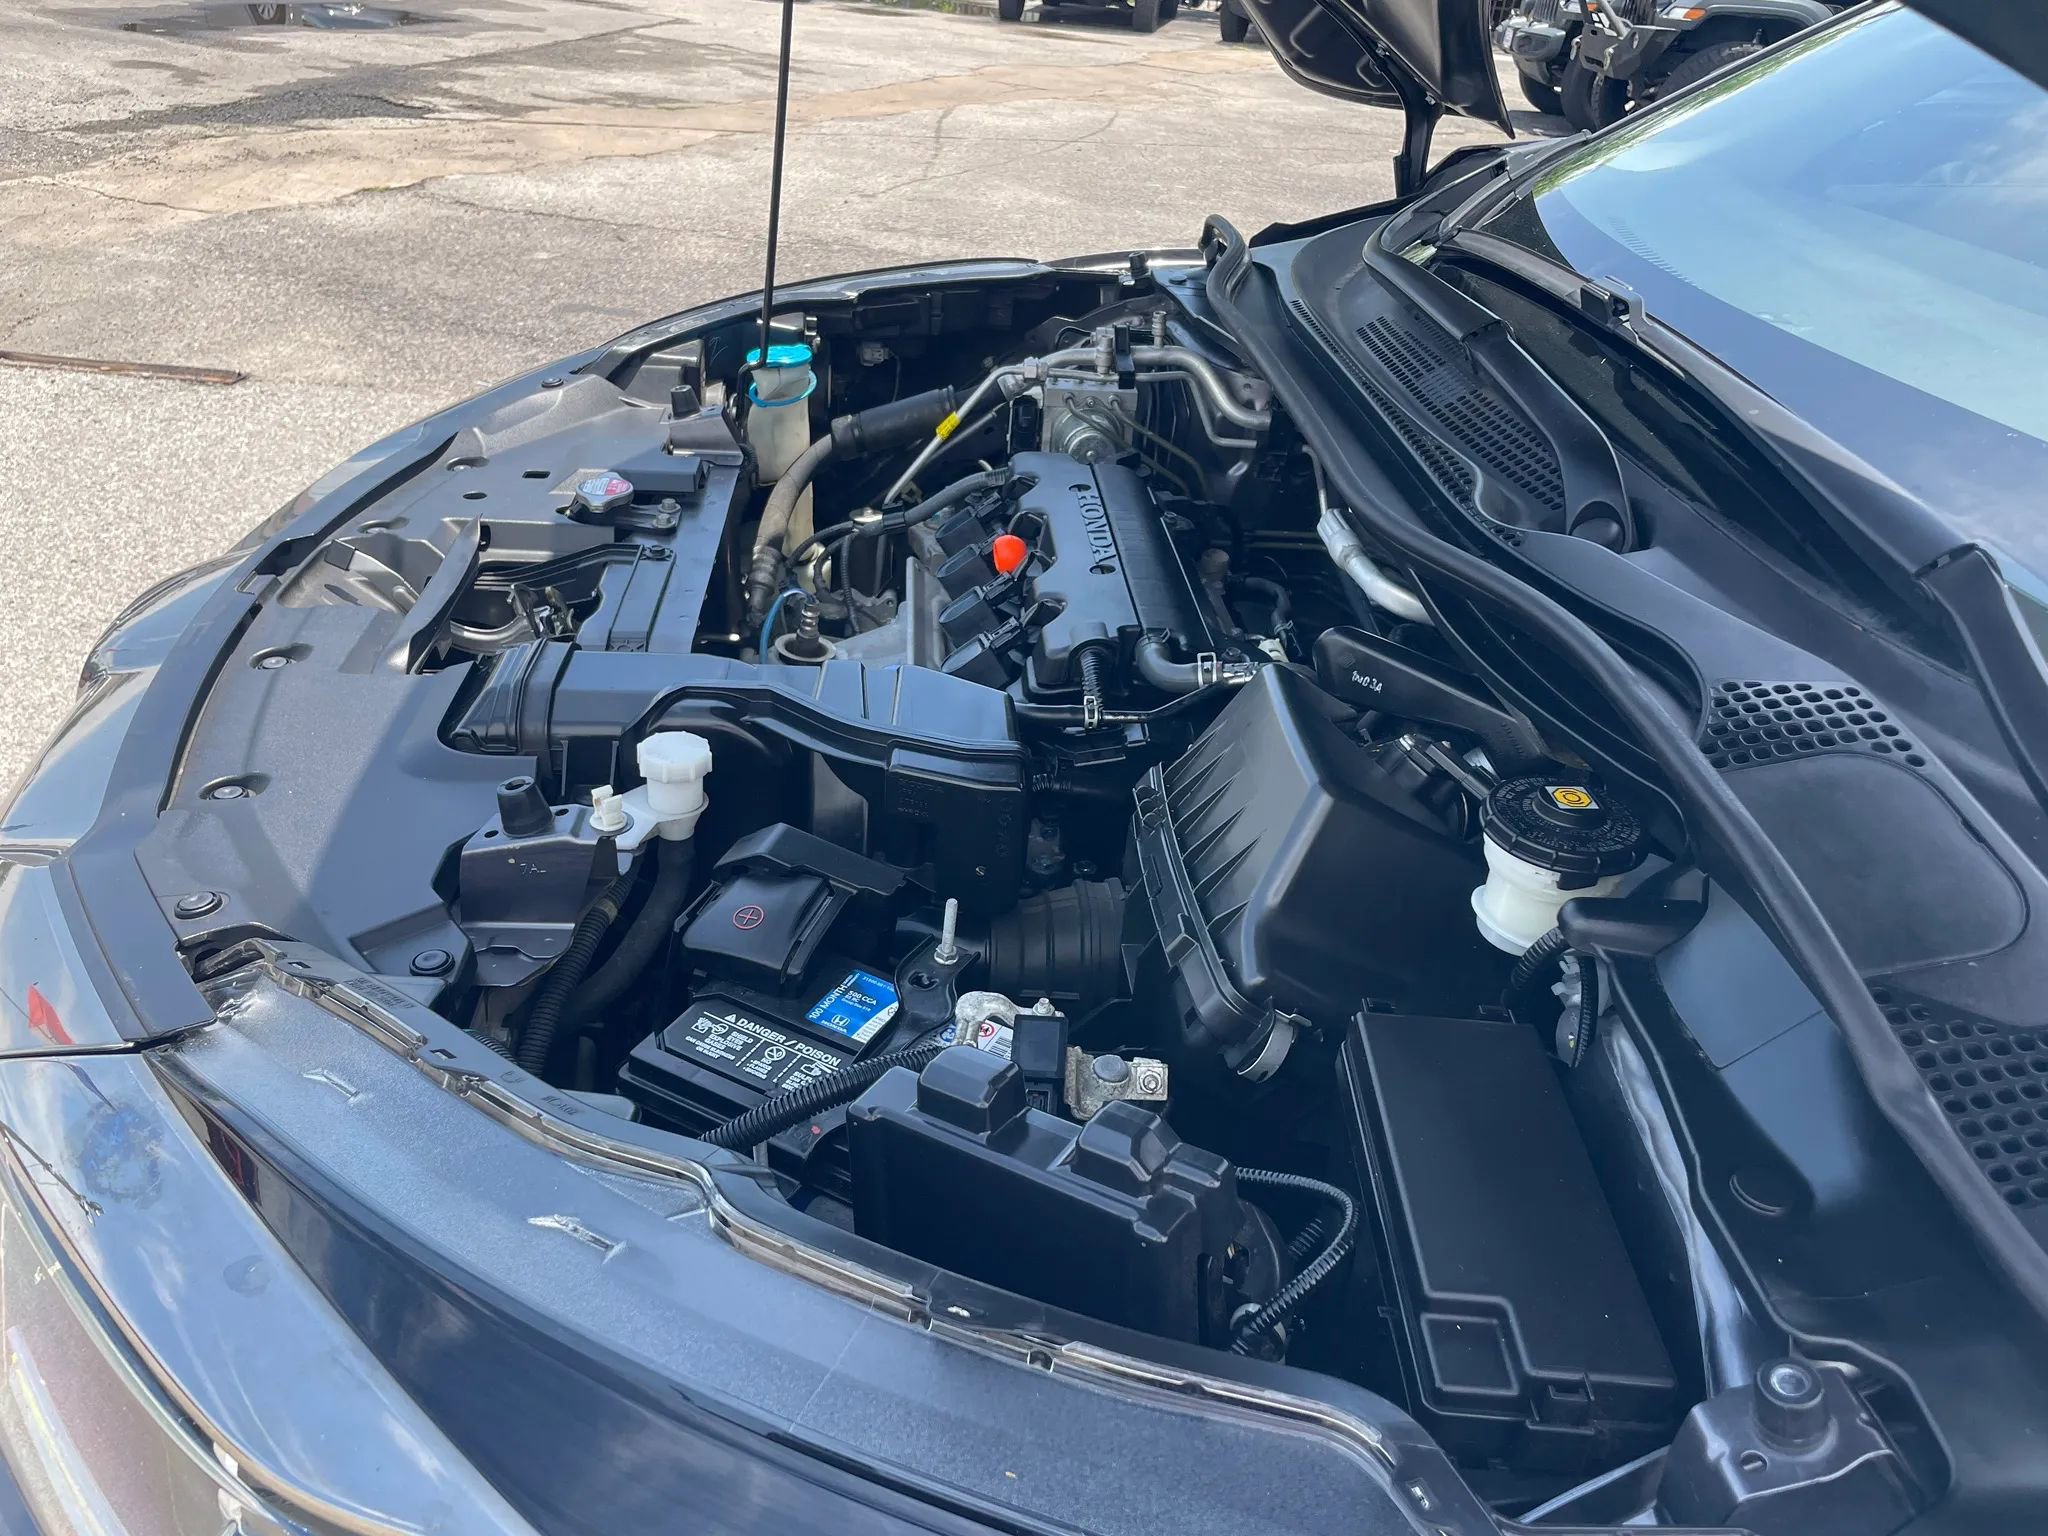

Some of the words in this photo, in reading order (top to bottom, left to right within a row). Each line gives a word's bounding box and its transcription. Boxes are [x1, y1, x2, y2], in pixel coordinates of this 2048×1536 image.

[1076, 494, 1117, 564] HONDA
[809, 1006, 824, 1020] 100
[823, 984, 847, 1008] MONTH
[848, 990, 862, 998] 500
[862, 996, 876, 1006] CCA
[821, 1020, 847, 1032] HONDA
[708, 1034, 743, 1051] EXPLOSIVE
[736, 1017, 786, 1044] DANGER
[795, 1042, 842, 1066] POISON
